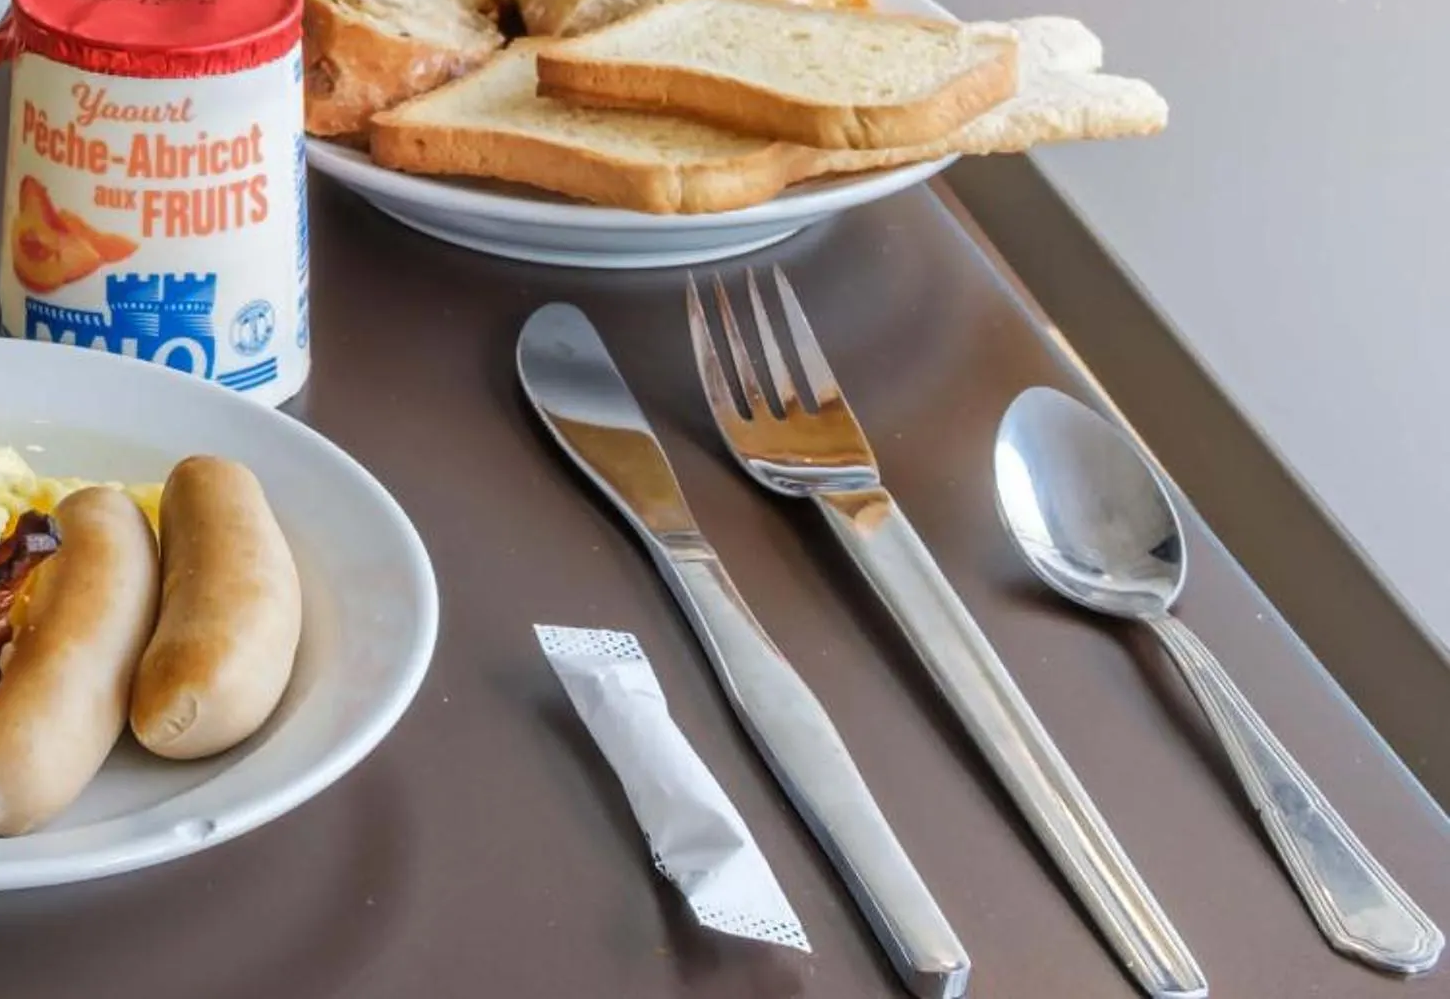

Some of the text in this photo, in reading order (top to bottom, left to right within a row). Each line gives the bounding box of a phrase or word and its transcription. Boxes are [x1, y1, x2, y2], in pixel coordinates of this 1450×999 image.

[71, 80, 196, 127] Yaourt
[22, 100, 264, 179] Pêche-Abricot
[93, 174, 268, 238] aux FRUITS
